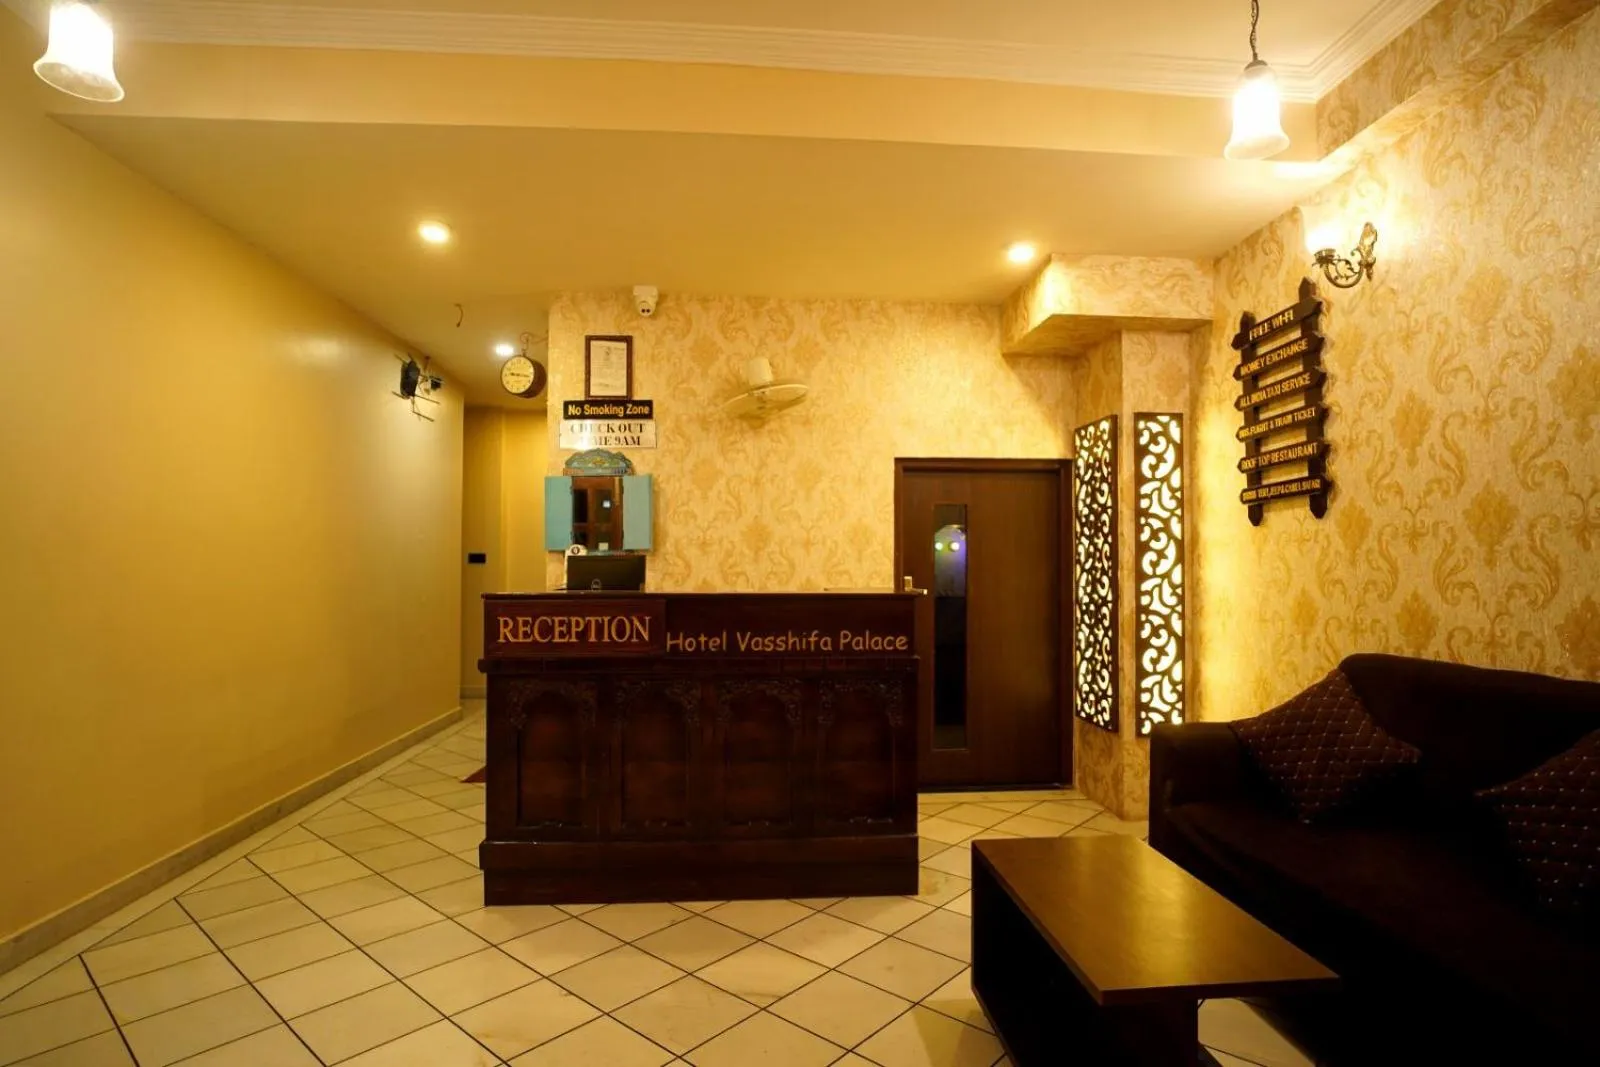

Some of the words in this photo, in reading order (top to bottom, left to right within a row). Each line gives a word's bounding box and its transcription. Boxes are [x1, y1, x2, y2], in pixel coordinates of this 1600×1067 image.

[1249, 321, 1271, 341] FREE
[1240, 357, 1267, 376] MONEY
[1266, 338, 1309, 367] EXCHANGE
[1281, 372, 1311, 393] SERVICE
[568, 404, 582, 416] No
[583, 403, 624, 417] Smoking
[626, 403, 650, 414] Zone
[1293, 407, 1316, 422] TICKET
[618, 422, 646, 434] OUT
[1270, 442, 1318, 463] RESTAURANT
[497, 615, 652, 643] RECEPTION
[666, 629, 727, 653] Hotel
[736, 629, 833, 652] Vasshifa
[839, 629, 909, 652] Palace
